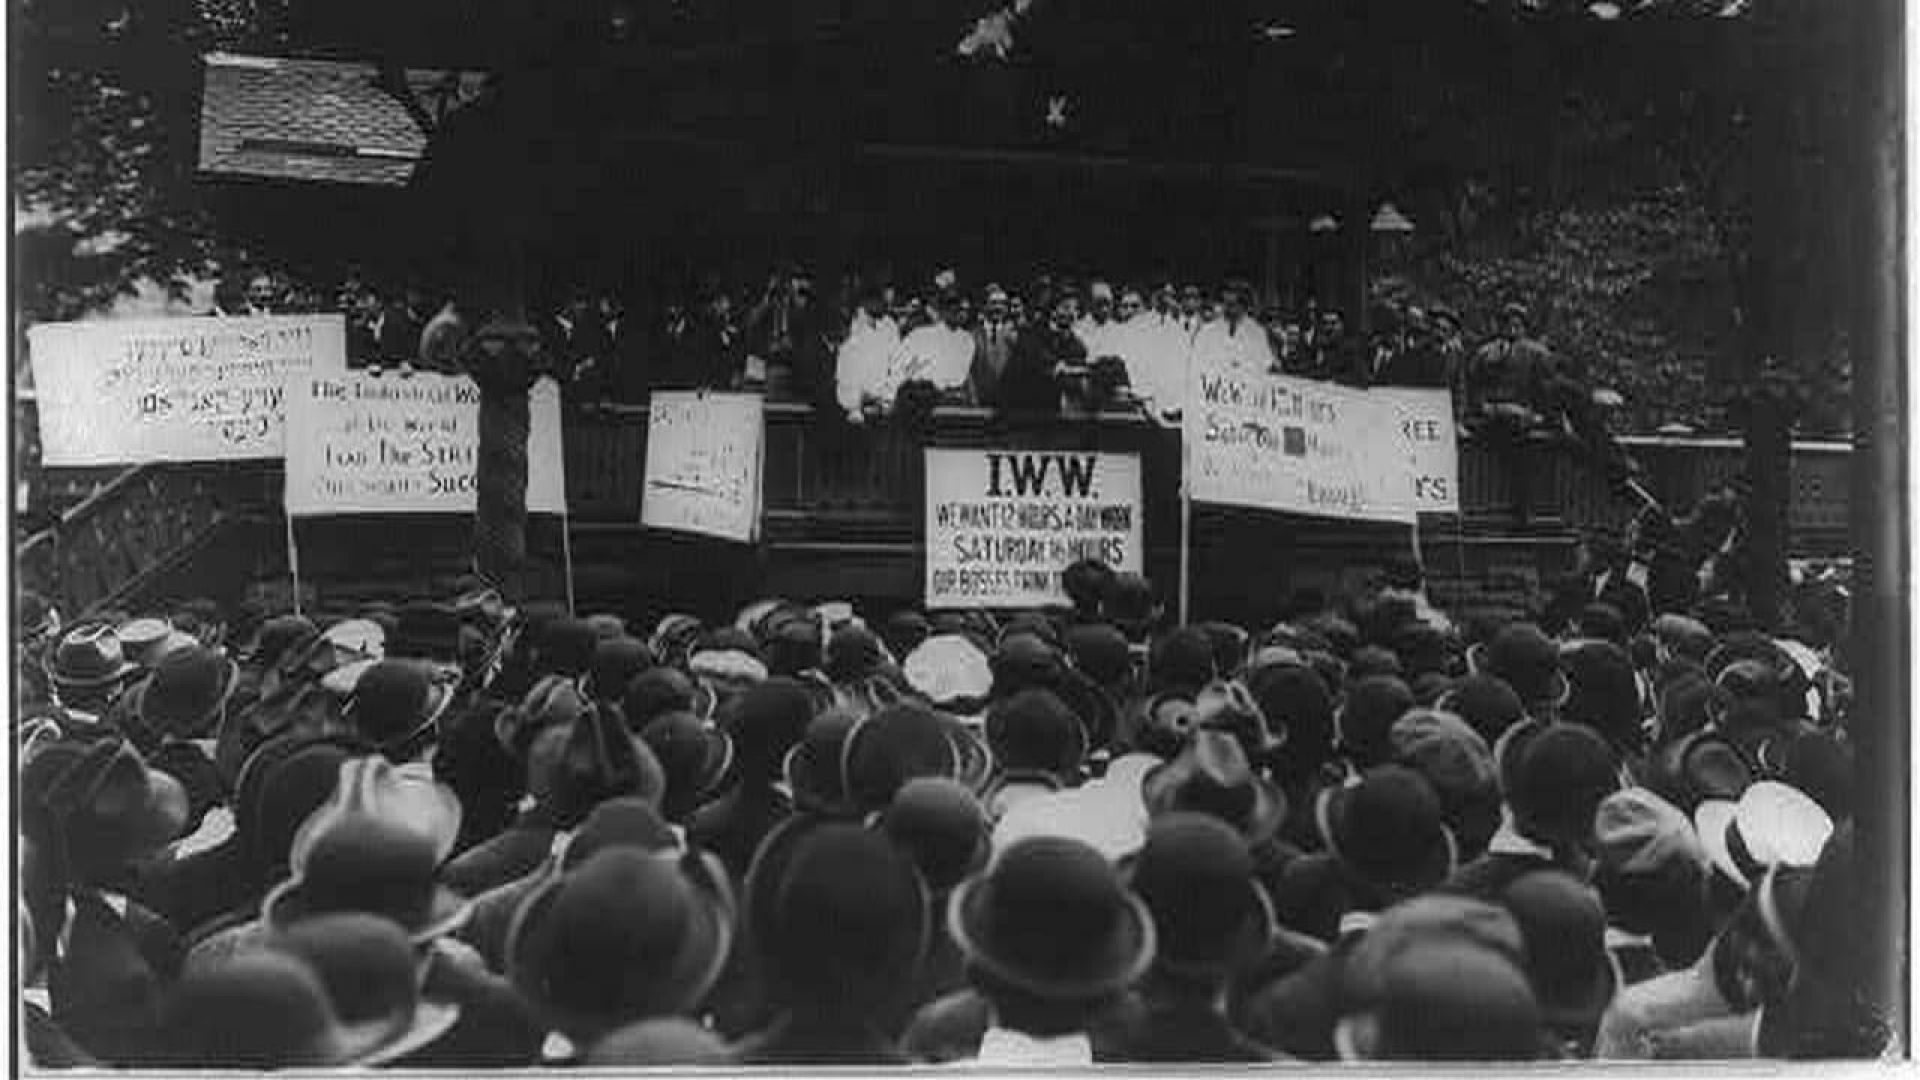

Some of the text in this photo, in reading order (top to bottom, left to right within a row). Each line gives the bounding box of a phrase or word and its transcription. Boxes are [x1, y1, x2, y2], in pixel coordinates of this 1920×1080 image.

[985, 454, 1100, 498] I.W.W.
[958, 503, 1001, 529] WANT
[953, 535, 1046, 564] SATURDAY
